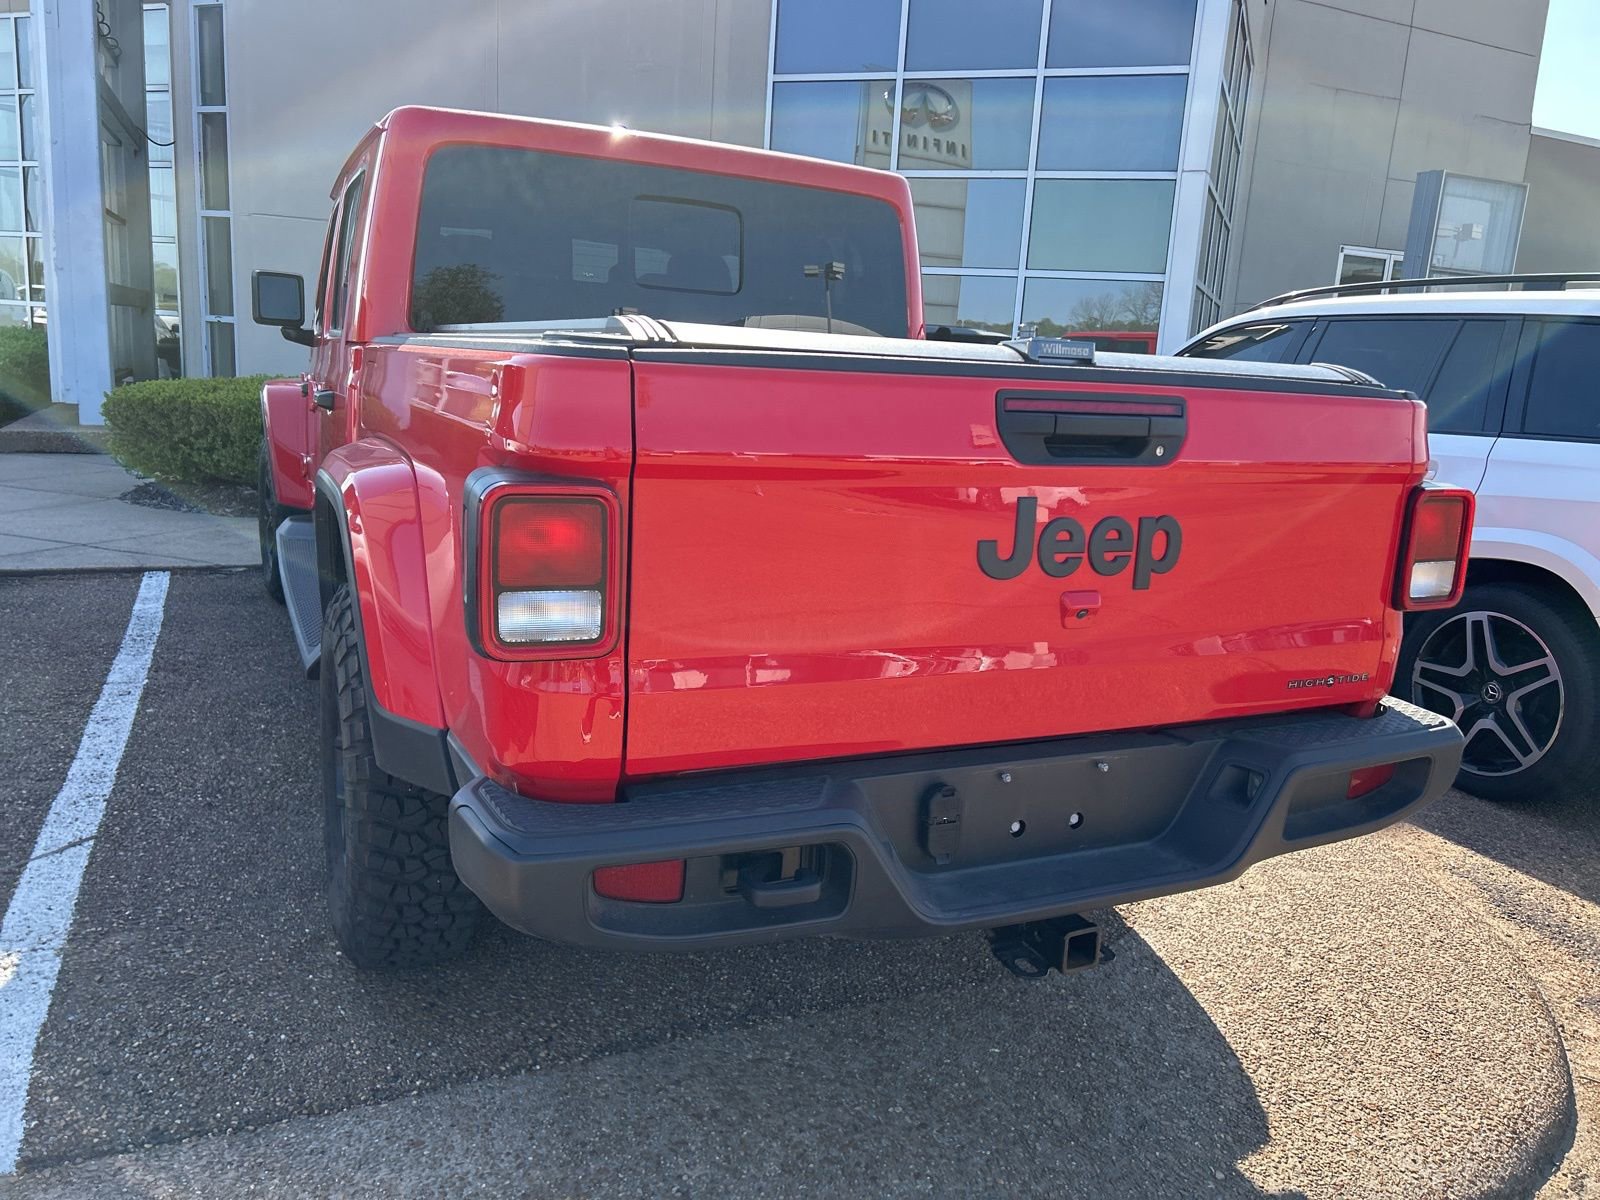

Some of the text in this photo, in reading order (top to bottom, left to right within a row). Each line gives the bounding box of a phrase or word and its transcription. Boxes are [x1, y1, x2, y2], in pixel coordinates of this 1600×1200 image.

[977, 496, 1182, 590] Jeep
[1288, 673, 1369, 689] HIGH TIDE
